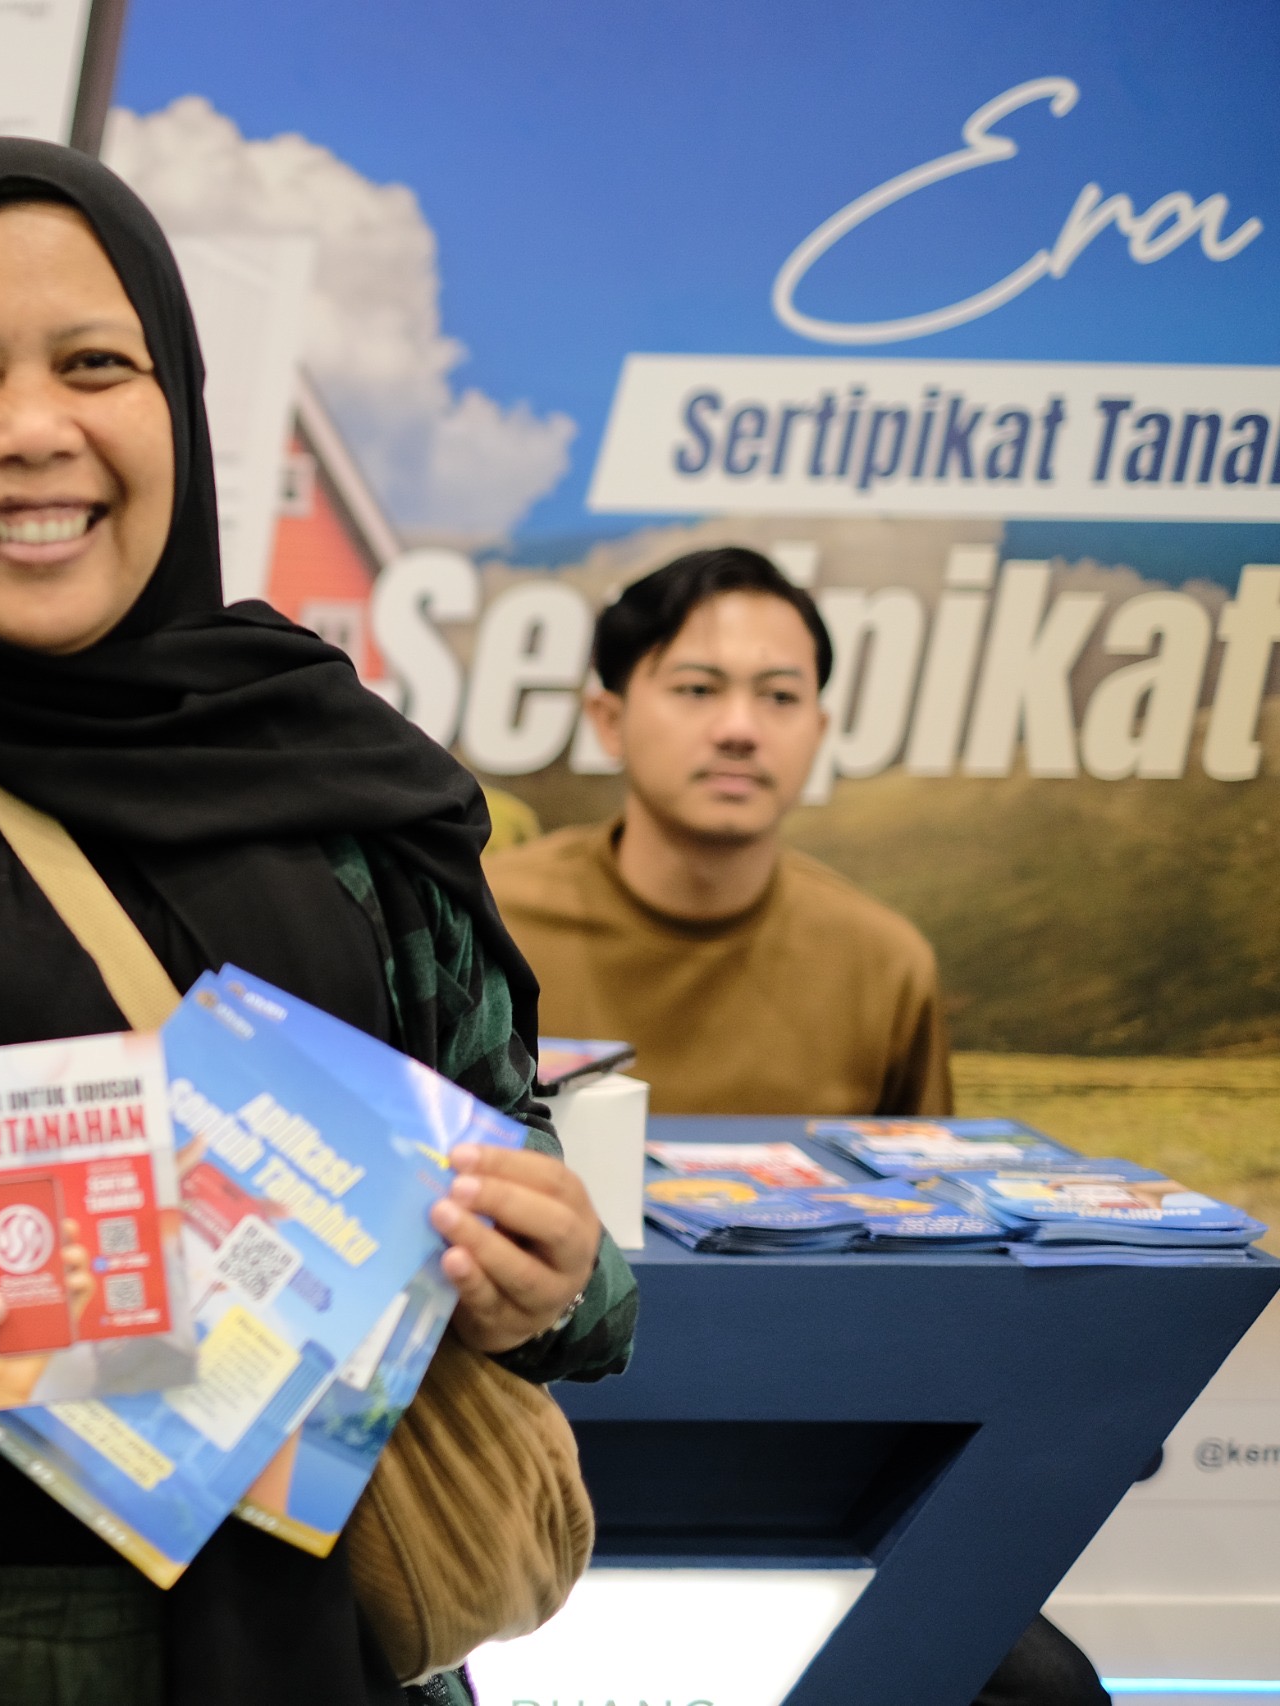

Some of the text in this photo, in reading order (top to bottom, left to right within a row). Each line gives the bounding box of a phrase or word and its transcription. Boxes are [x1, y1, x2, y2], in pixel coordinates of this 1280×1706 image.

[772, 76, 1263, 345] Era
[675, 384, 1066, 492] Sertipikat
[373, 541, 1280, 805] Sepikat
[236, 1092, 366, 1197] Aplikasi
